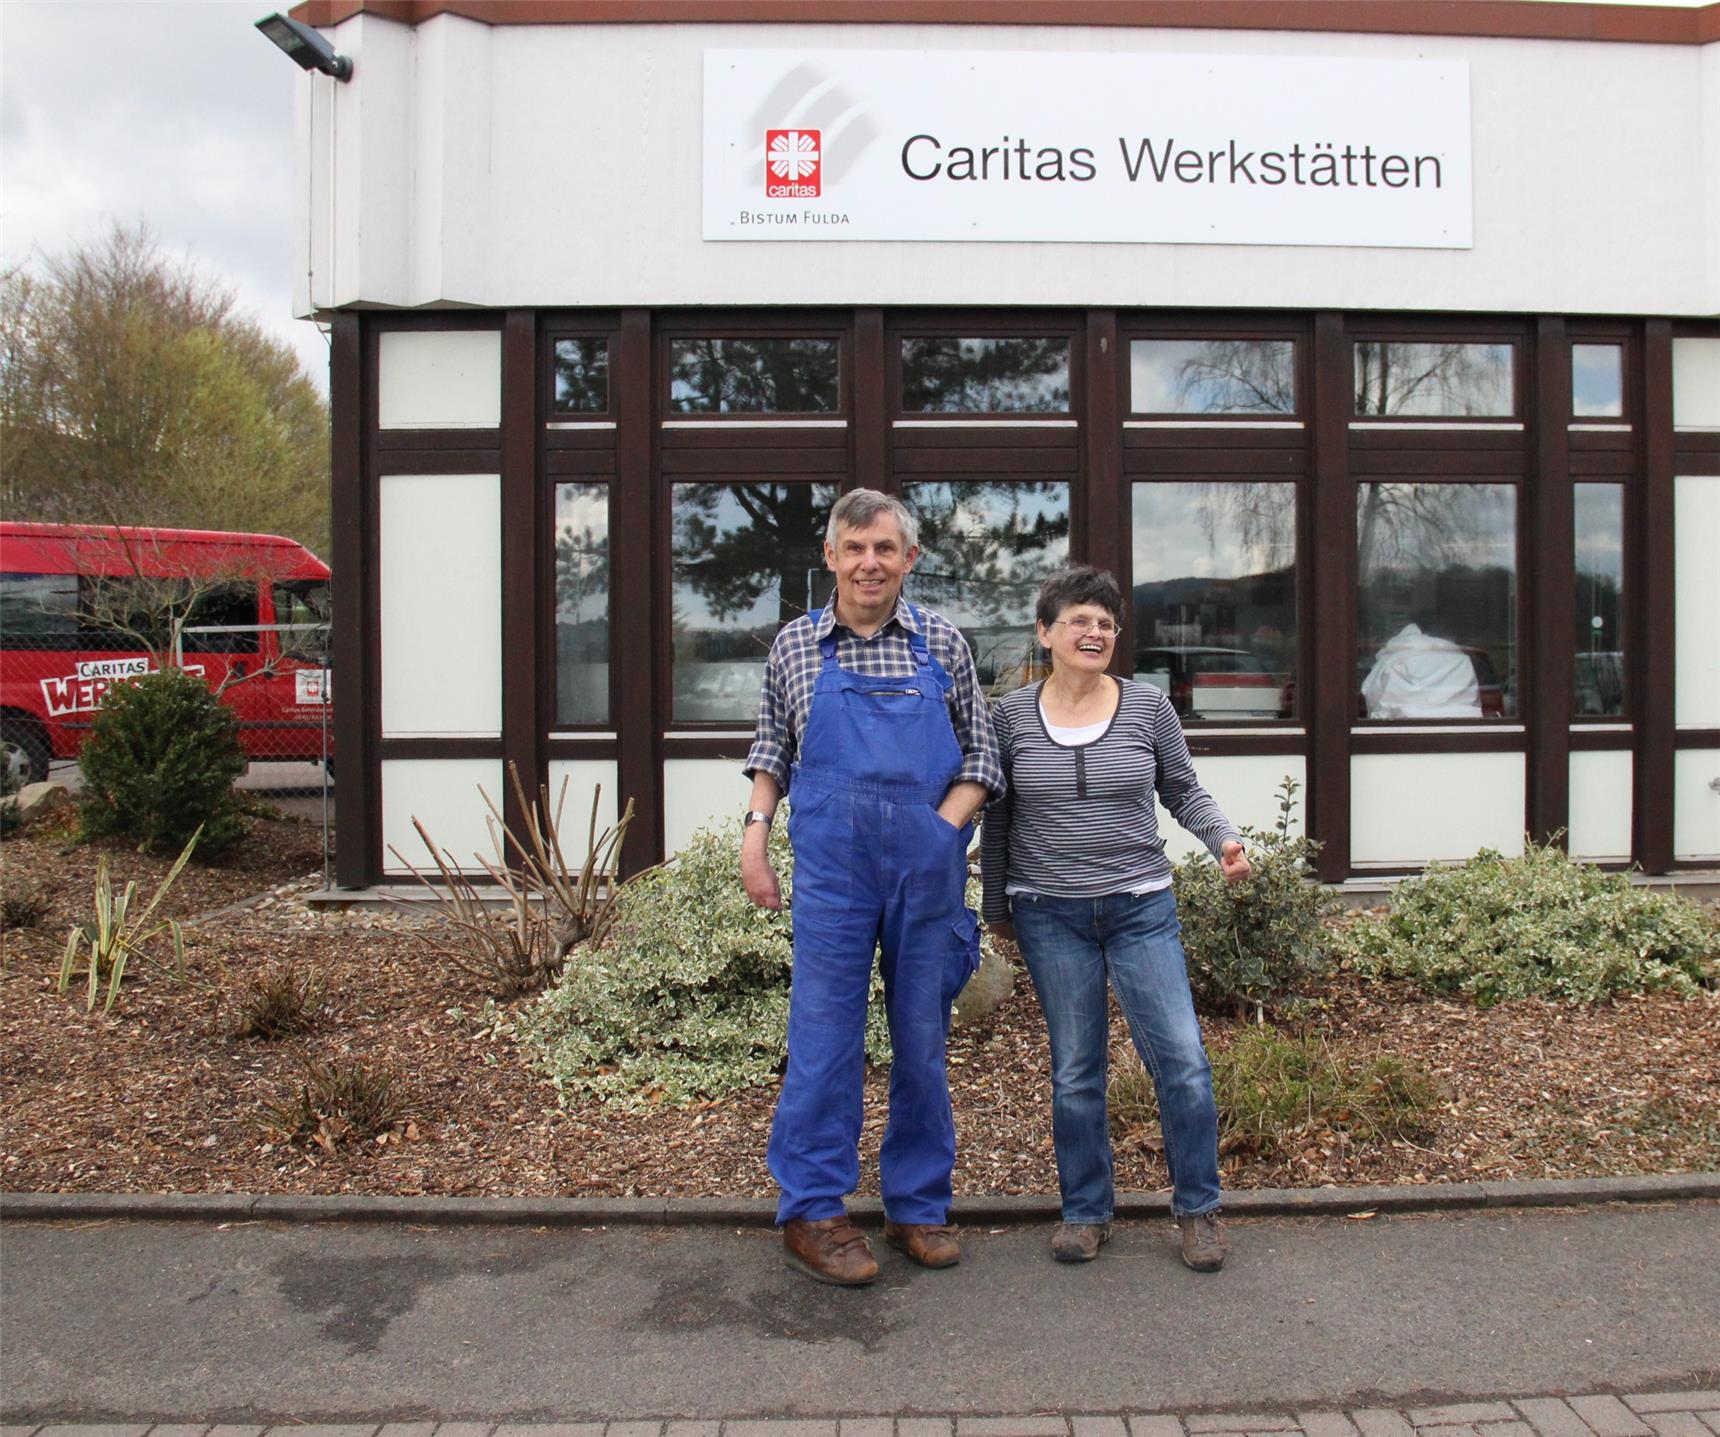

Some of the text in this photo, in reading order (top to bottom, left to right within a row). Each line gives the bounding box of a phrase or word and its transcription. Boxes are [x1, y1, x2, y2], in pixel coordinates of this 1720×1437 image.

[901, 134, 1442, 188] Caritas Werkstätten
[768, 182, 817, 197] caritas
[740, 211, 850, 224] BISTUM FULDA
[80, 661, 147, 677] CARITAS
